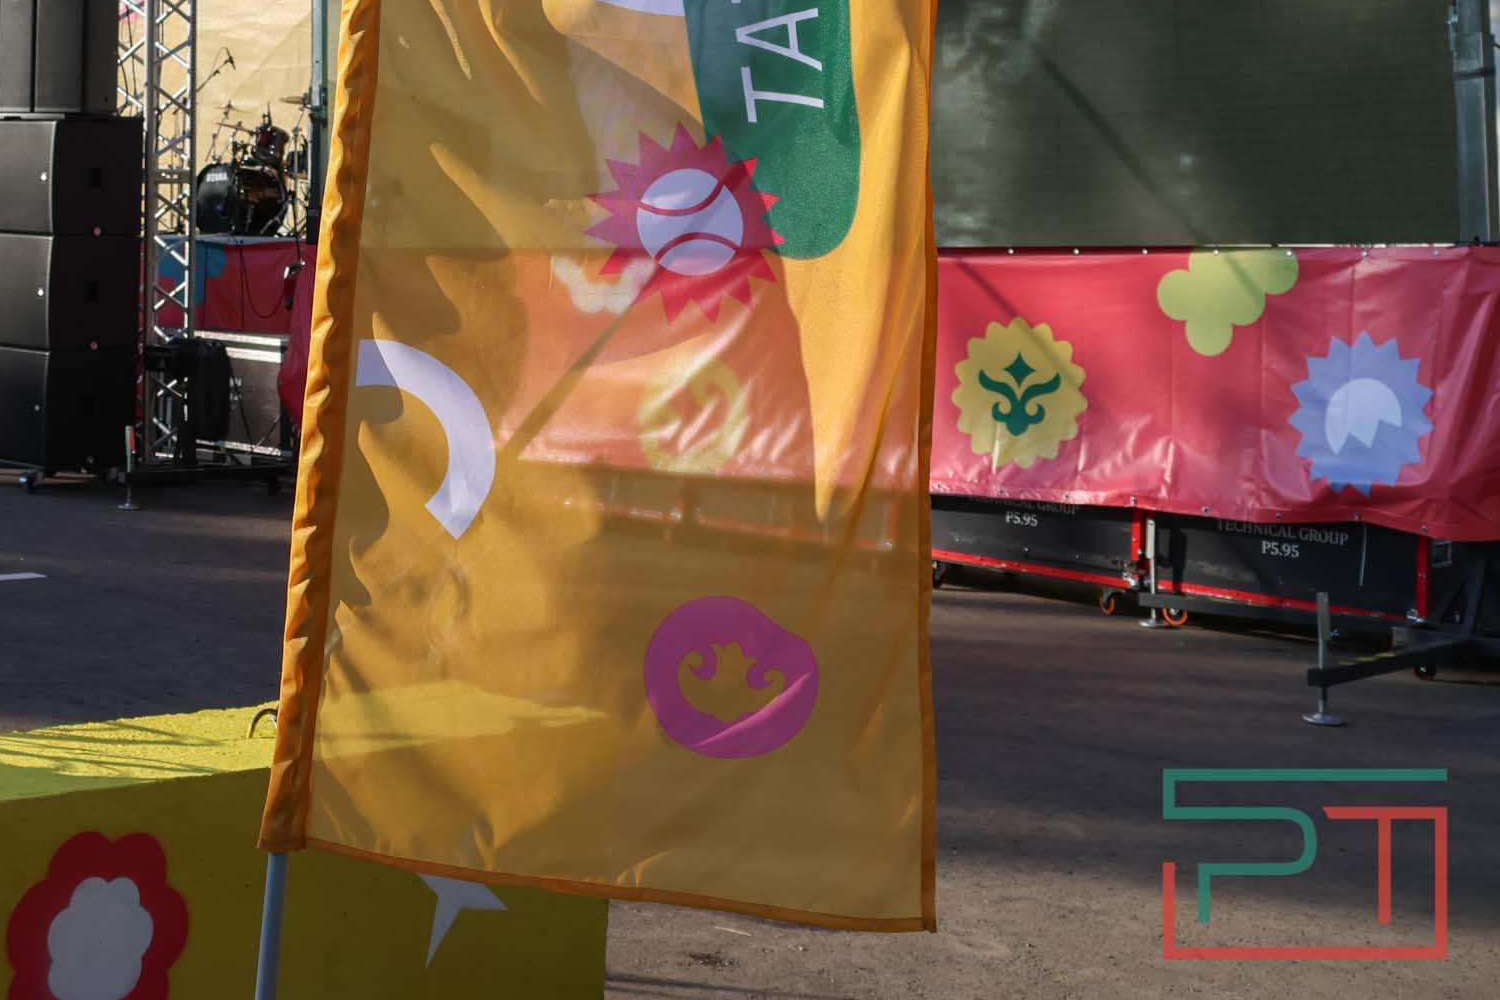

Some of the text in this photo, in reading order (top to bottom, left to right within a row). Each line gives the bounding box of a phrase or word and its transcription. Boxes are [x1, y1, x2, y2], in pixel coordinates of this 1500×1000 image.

[1005, 510, 1038, 527] P5.95
[1299, 527, 1349, 546] GROUP
[1261, 540, 1300, 558] P5.95
